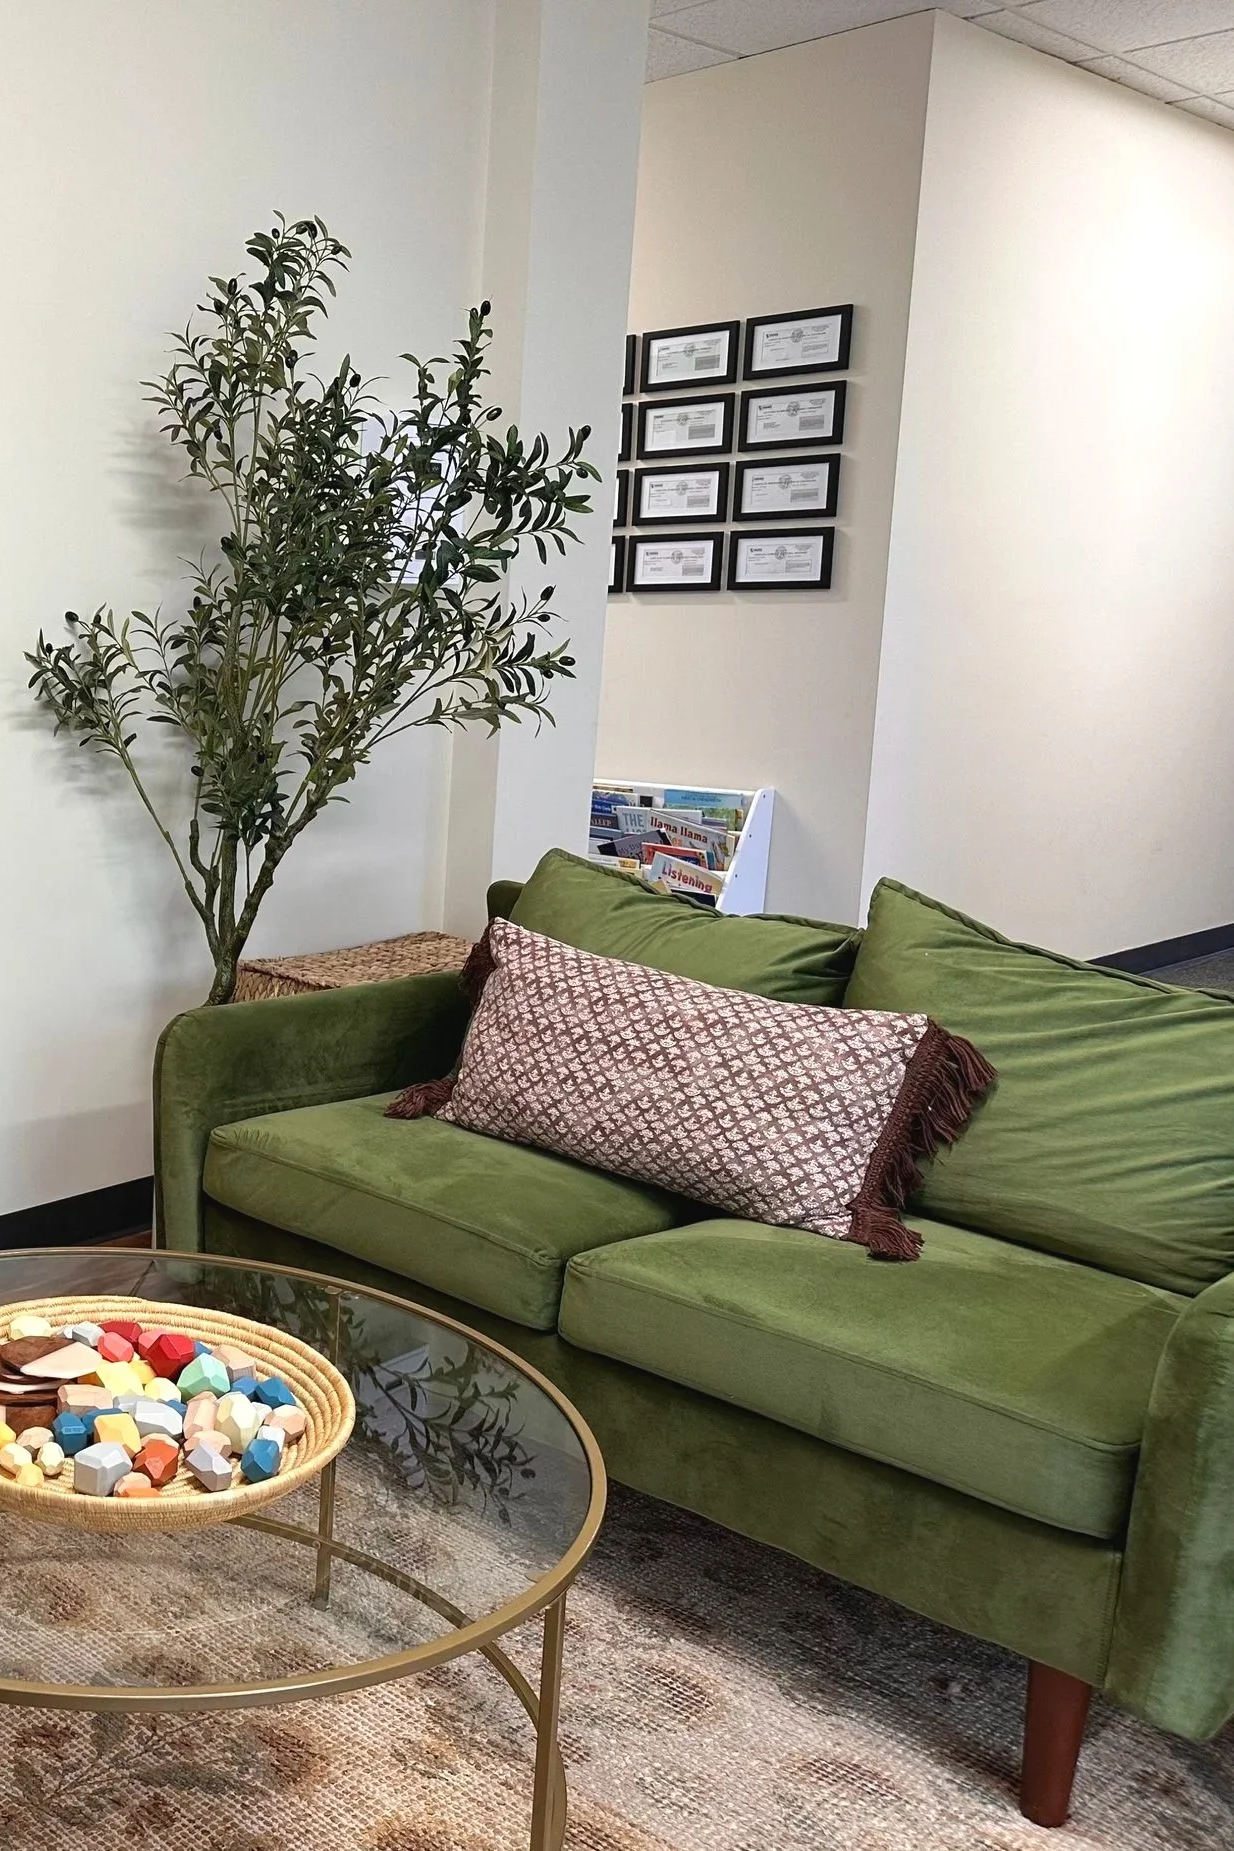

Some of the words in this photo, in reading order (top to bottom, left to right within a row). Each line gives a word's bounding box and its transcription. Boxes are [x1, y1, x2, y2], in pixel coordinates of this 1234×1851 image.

[623, 812, 644, 828] THE
[651, 816, 677, 833] llama
[680, 826, 708, 843] llama
[662, 862, 713, 893] Listening
